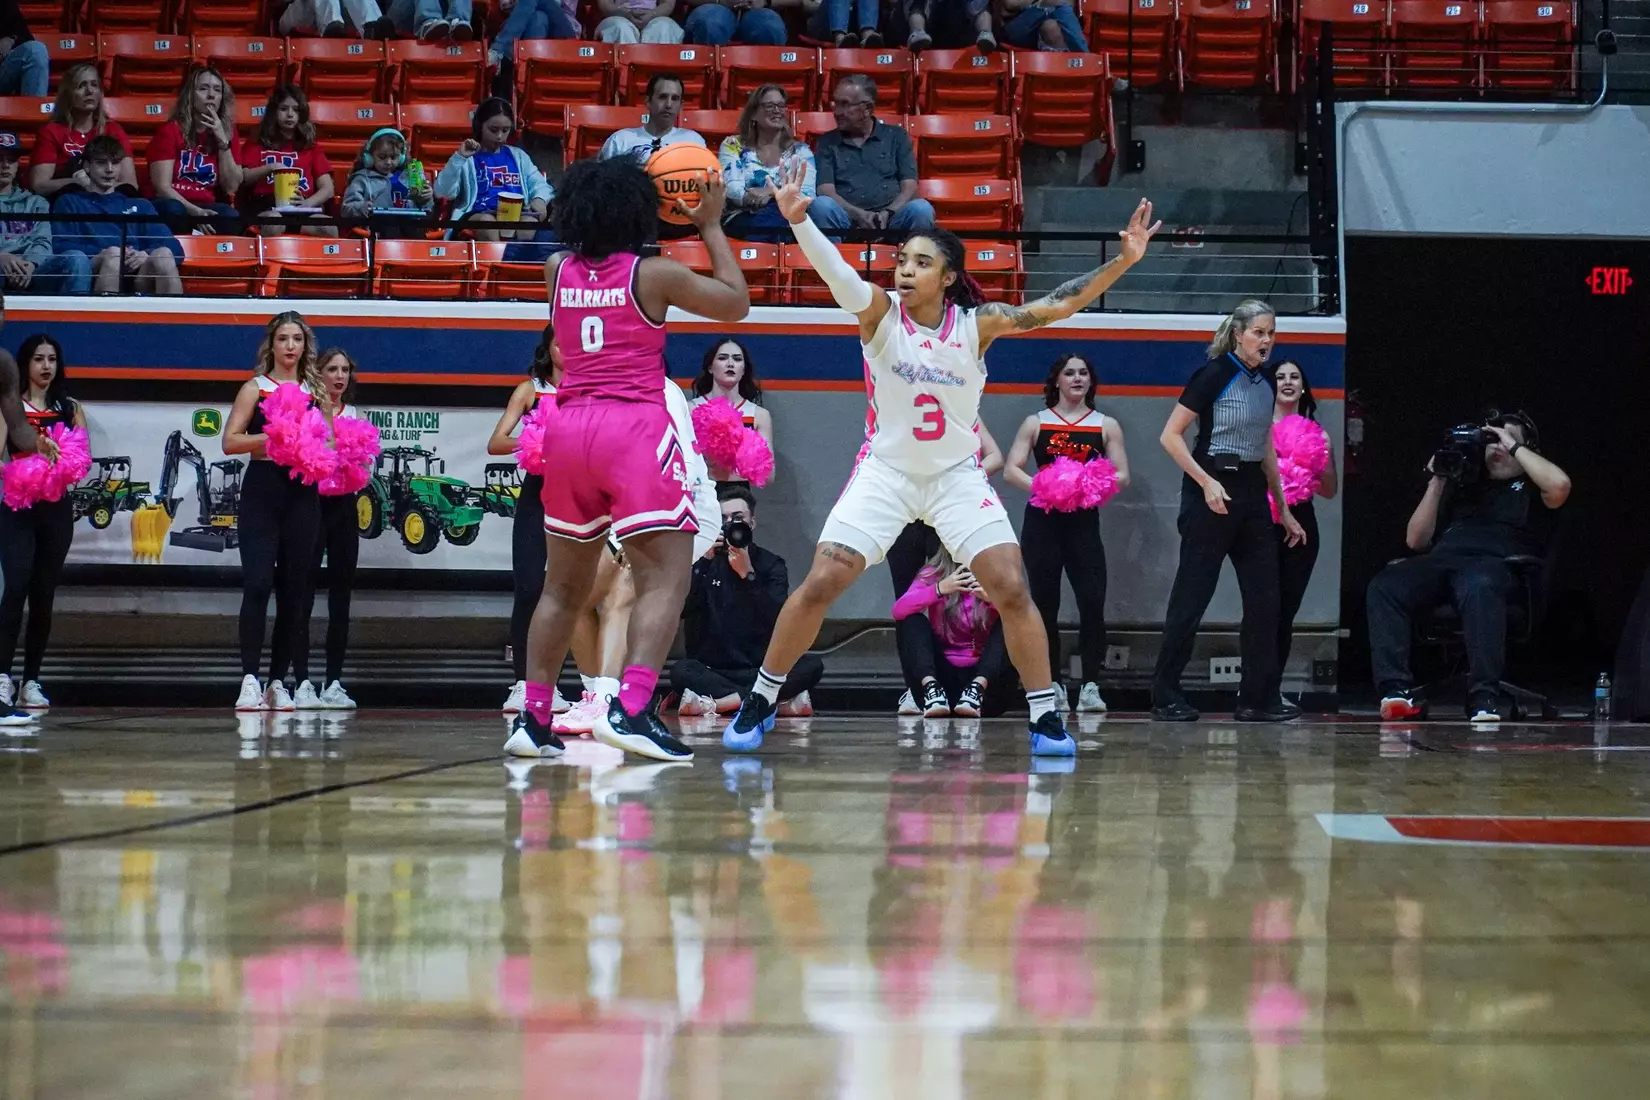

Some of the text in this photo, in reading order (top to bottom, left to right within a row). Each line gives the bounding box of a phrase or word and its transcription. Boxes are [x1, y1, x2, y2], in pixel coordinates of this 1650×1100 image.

[1355, 4, 1366, 13] 28
[1539, 7, 1550, 15] 30
[63, 40, 72, 48] 13
[158, 41, 166, 49] 14
[252, 43, 261, 51] 15
[351, 45, 360, 54] 16
[583, 48, 592, 56] 18
[683, 51, 692, 59] 19
[783, 53, 794, 62] 20
[880, 55, 889, 63] 21
[975, 57, 986, 65] 22
[45, 103, 51, 112] 9
[149, 105, 158, 114] 10
[361, 110, 370, 118] 12
[978, 121, 988, 129] 17
[222, 243, 228, 252] 5
[328, 245, 334, 254] 6
[435, 247, 441, 256] 7
[746, 250, 752, 259] 9
[981, 251, 990, 260] 11
[1591, 266, 1629, 295] EXIT
[560, 287, 627, 308] BEARKATS
[580, 315, 605, 353] 0
[397, 411, 440, 429] RANCH
[912, 393, 947, 441] 3
[400, 430, 421, 441] TURF
